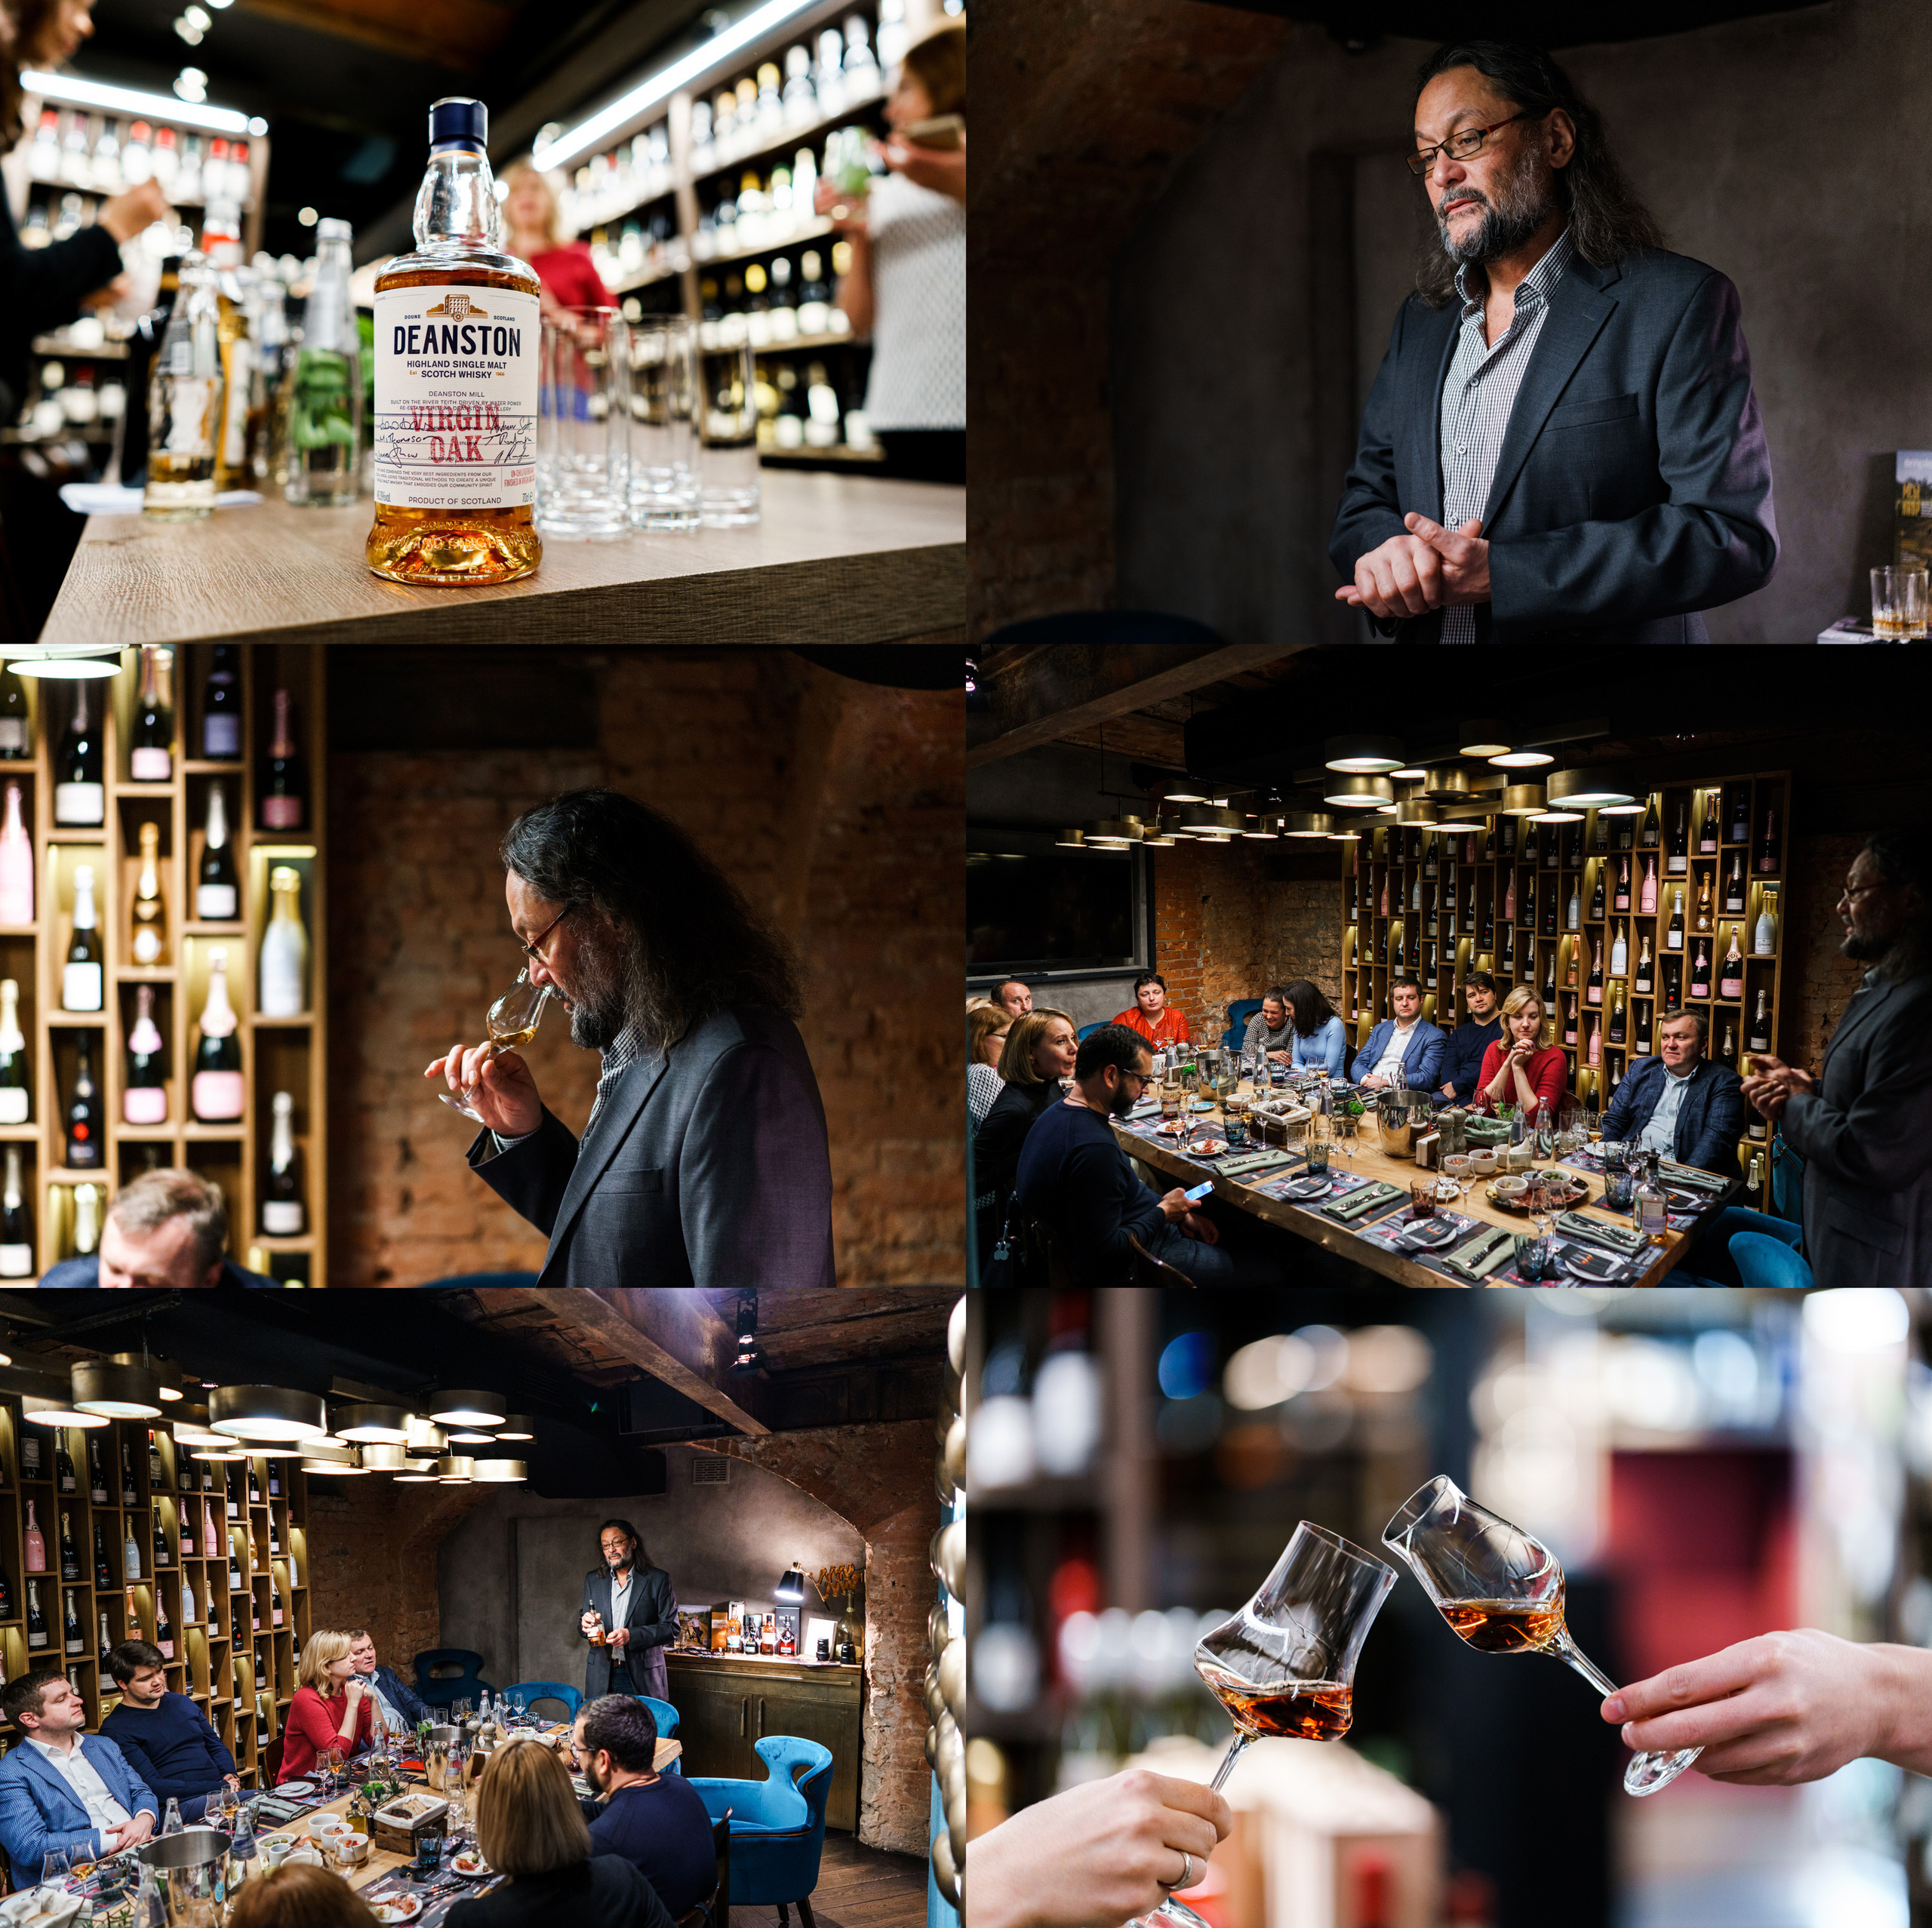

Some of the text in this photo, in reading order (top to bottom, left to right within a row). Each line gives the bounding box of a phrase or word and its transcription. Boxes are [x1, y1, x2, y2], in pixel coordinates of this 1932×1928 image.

[393, 324, 521, 357] DEANSTON
[407, 360, 507, 369] HIGHLAND SINGLE MALT
[421, 370, 492, 379] SCOTCH WHISKY
[410, 404, 501, 432] VIRGIN
[429, 435, 485, 464] OAK
[408, 496, 445, 505] PRODUCT
[461, 497, 502, 506] SCOTLAND
